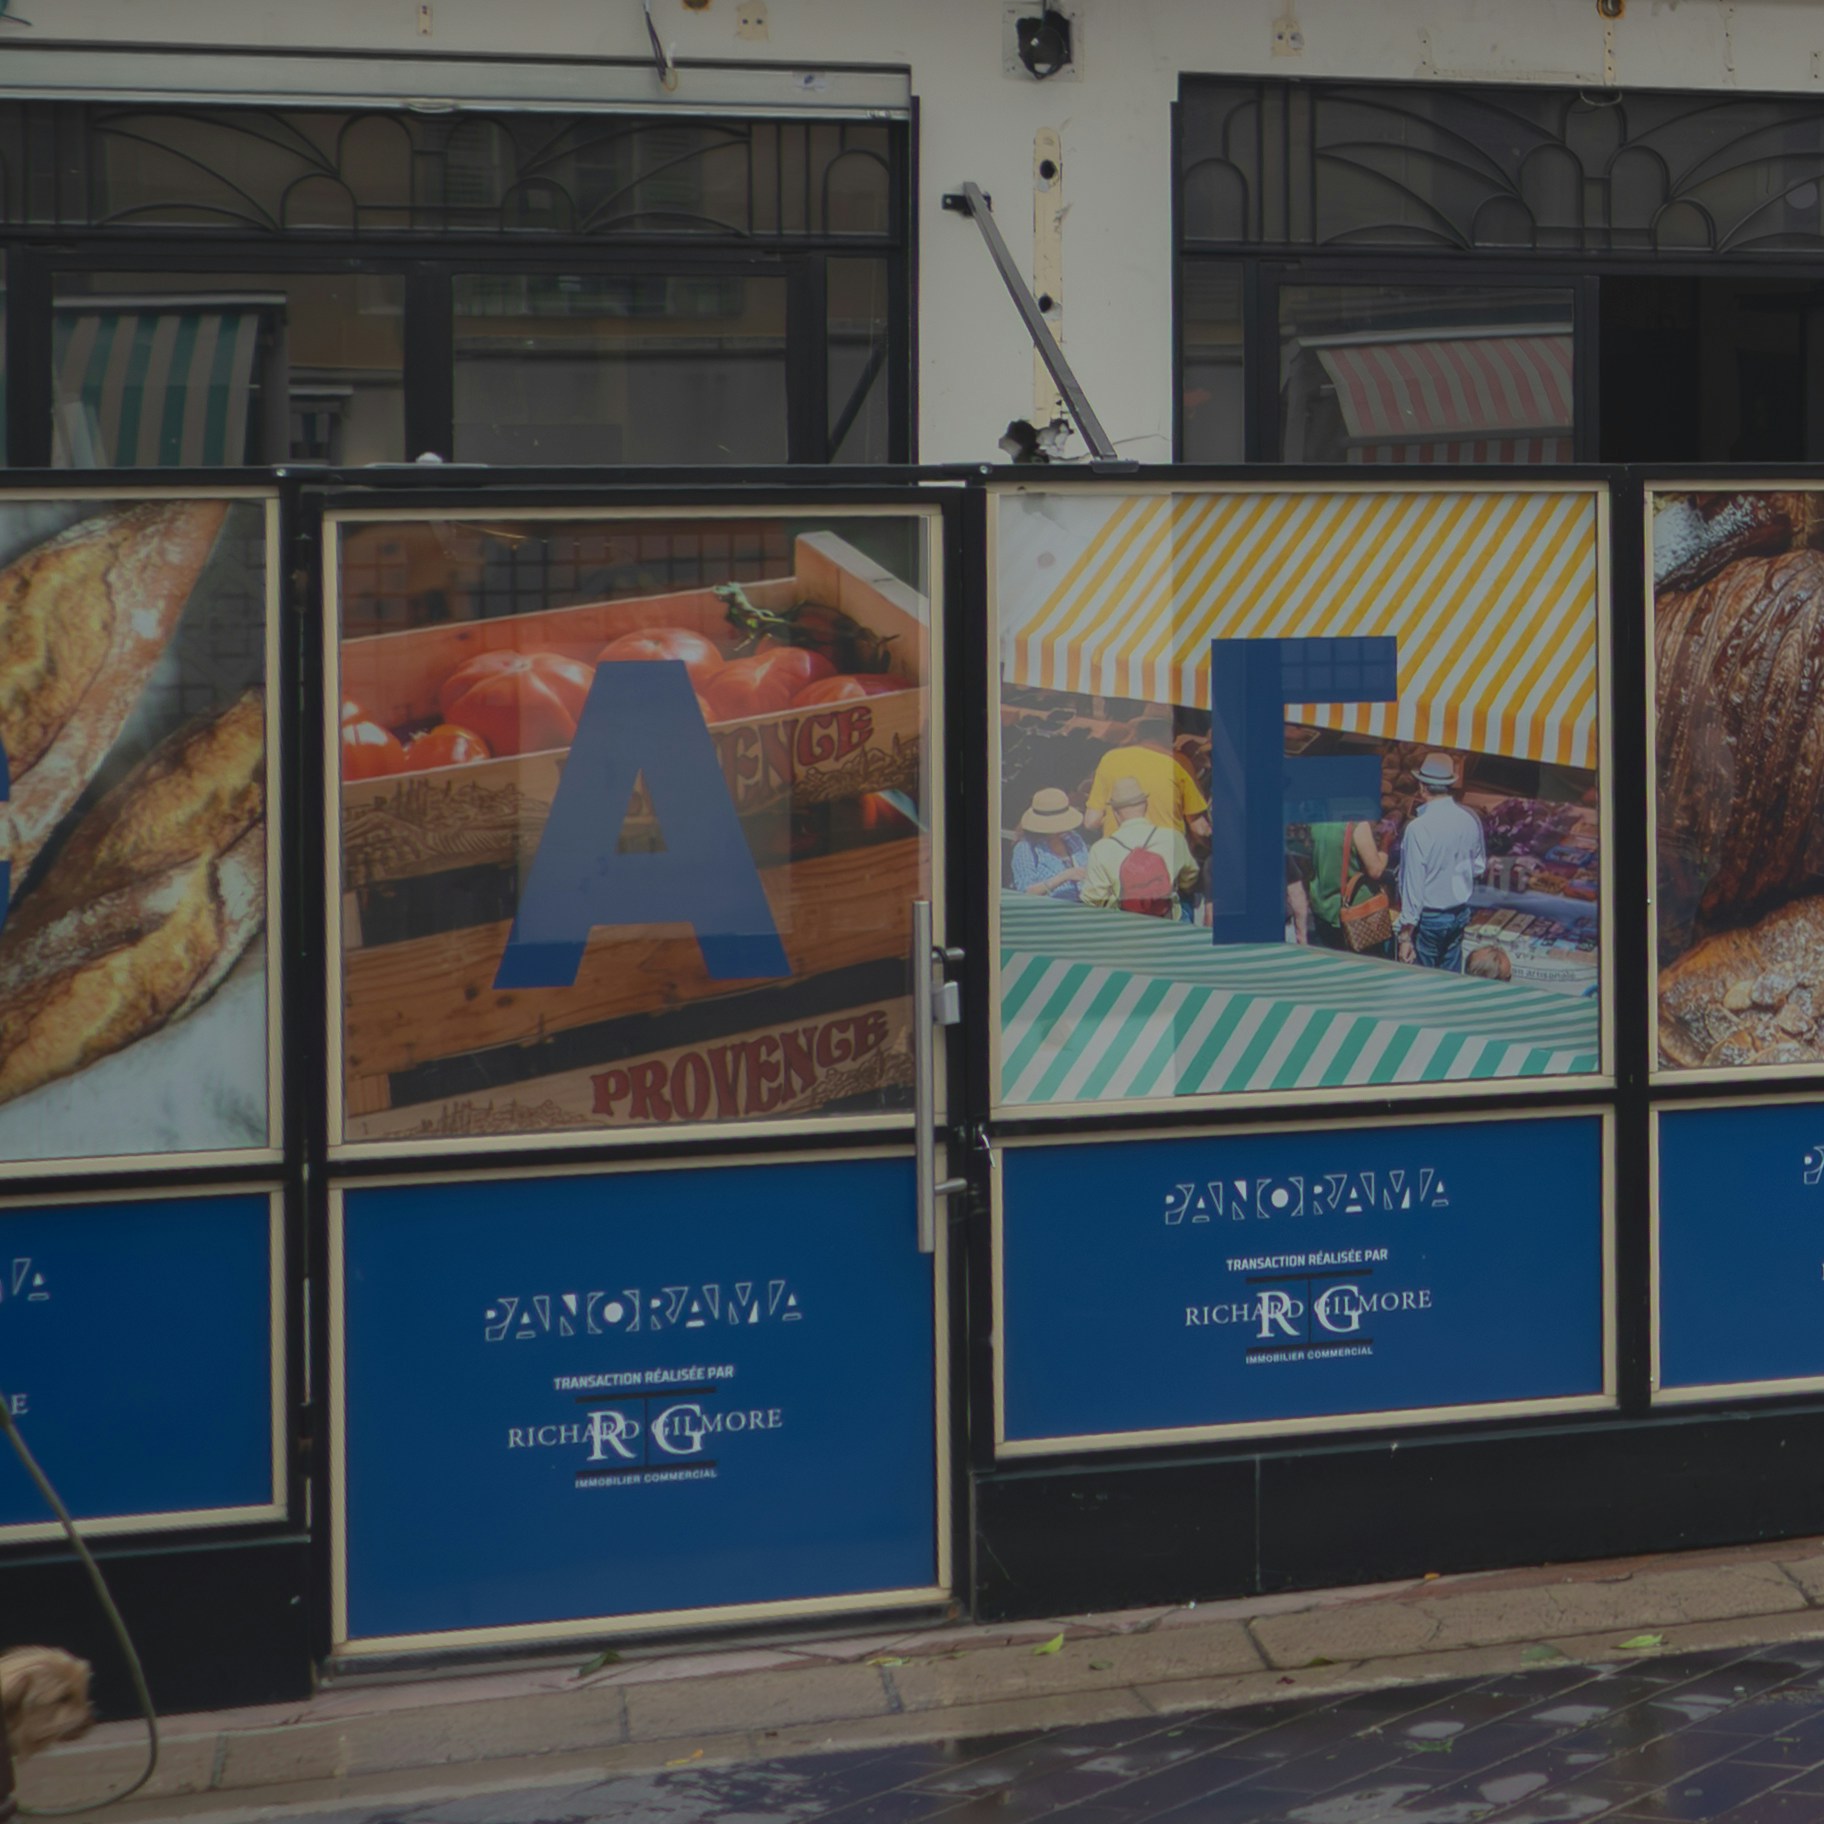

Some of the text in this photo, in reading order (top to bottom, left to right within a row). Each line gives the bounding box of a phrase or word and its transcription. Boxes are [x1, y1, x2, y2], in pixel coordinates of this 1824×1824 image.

[589, 1009, 889, 1122] PROVENCE
[1165, 1168, 1449, 1225] PANORAMA
[1226, 1249, 1388, 1271] TRANSACTION RÉALISÉE PAR
[485, 1280, 802, 1341] PANORAMA
[1246, 1348, 1373, 1365] IMMOBILIER COMMERCIAL
[554, 1365, 734, 1390] TRANSACTION RÉALISÉE PAR
[575, 1470, 717, 1488] IMMOBILIER COMMERCIAL
